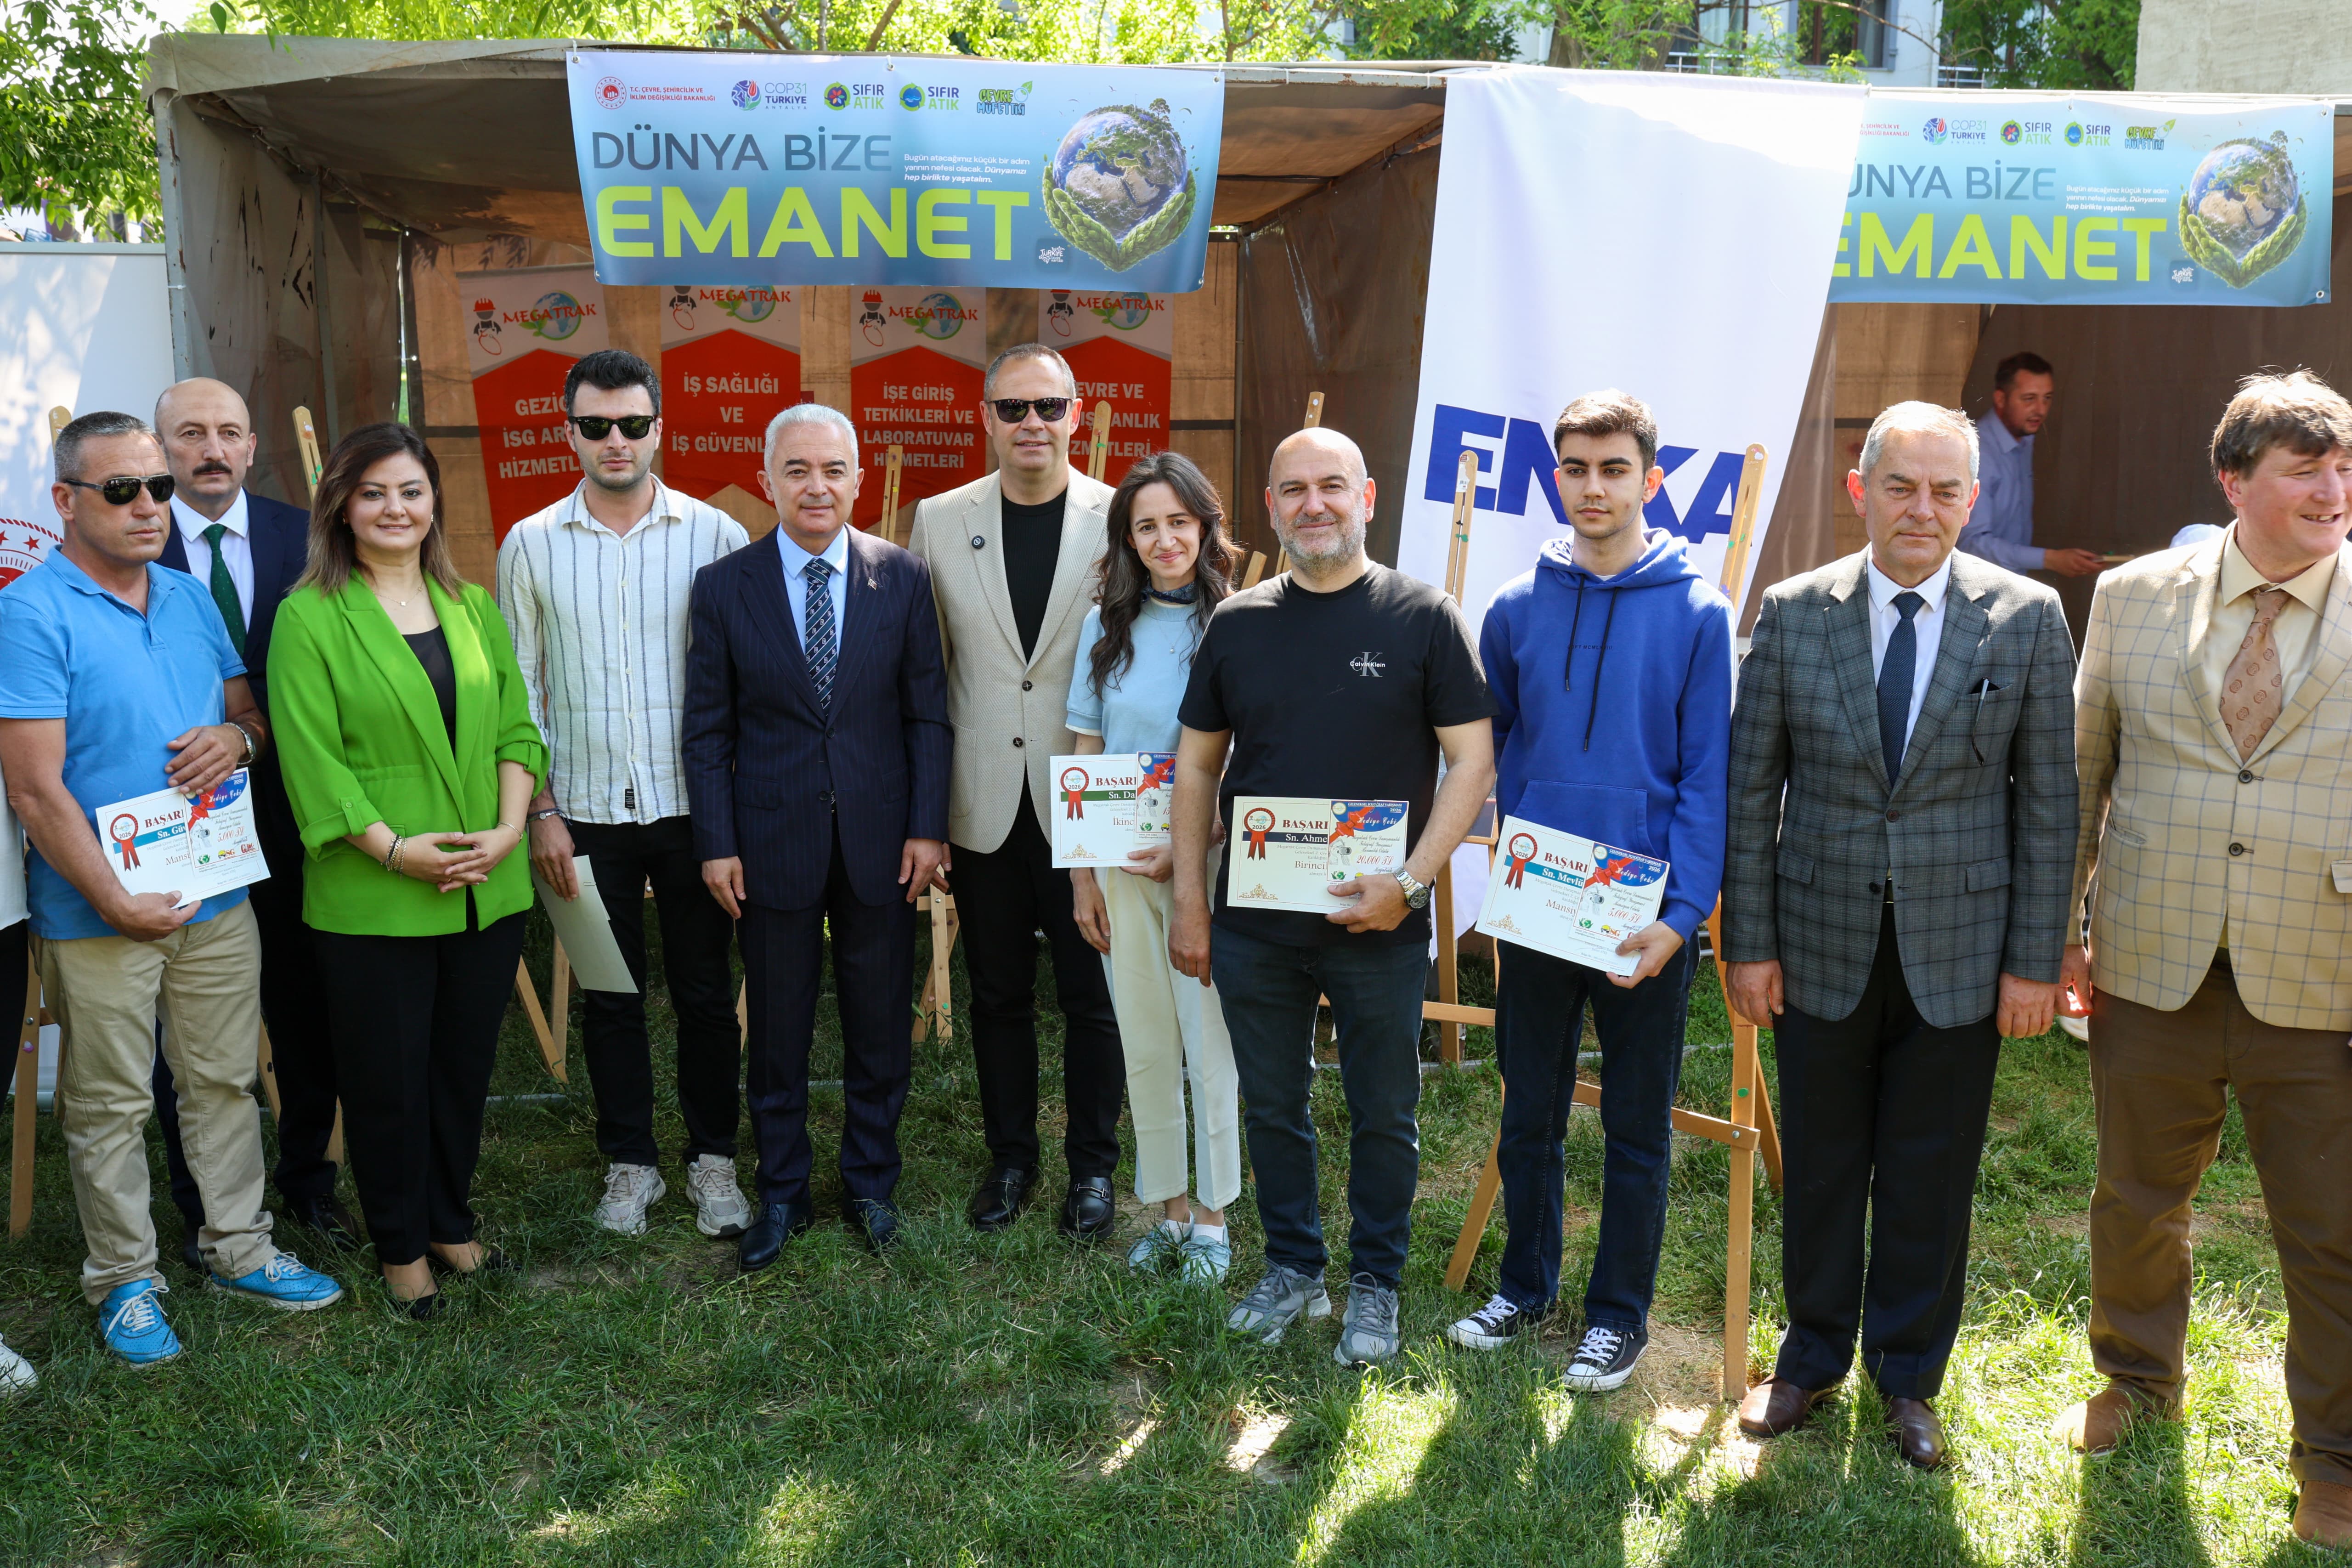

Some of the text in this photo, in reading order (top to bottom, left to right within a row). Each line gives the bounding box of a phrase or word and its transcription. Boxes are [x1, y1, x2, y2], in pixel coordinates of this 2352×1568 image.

[765, 82, 807, 93] COP31
[853, 84, 884, 96] SIFIR
[928, 86, 959, 98] SIFIR
[765, 95, 807, 104] TÜRKİYE
[854, 97, 884, 109] ATIK
[979, 89, 1014, 104] ÇEVRE
[928, 98, 959, 110] ATIK
[1951, 120, 1987, 130] COP31
[2025, 122, 2052, 133] SIFIR
[2086, 125, 2110, 135] SIFIR
[1951, 131, 1986, 140] TÜRKİYE
[2025, 133, 2051, 145] ATIK
[2086, 136, 2110, 146] ATIK
[593, 124, 892, 171] DÜNYA BİZE
[974, 156, 997, 164] küçük
[984, 166, 1026, 175] Dünyamızı
[952, 175, 992, 183] yaşatalım.
[1966, 159, 2057, 201] BİZE
[596, 186, 1029, 260] EMANET
[700, 289, 791, 302] MEGATRAK
[1077, 297, 1165, 311] MEGATRAK
[503, 304, 597, 323] MEGATRAK
[889, 306, 978, 321] MEGATRAK
[684, 371, 779, 397] İŞ SAĞLIĞI
[1076, 382, 1144, 399] EVRE VE
[883, 382, 955, 405] İŞE GİRİŞ
[515, 392, 566, 416] GEZİC
[720, 407, 744, 423] VE
[864, 405, 974, 424] TETKİKLERİ VE
[1080, 411, 1160, 430] IŞANLIK
[503, 426, 567, 448] İSG AR
[672, 431, 765, 456] İŞ GÜVENL
[864, 430, 974, 446] LABORATUVAR
[1070, 438, 1151, 457] ZMTLERİ
[874, 449, 964, 468] HİMETLERİ
[499, 455, 581, 479] HİZMETL
[1113, 816, 1134, 826] İkinc
[1283, 819, 1329, 831] BAŞARI
[158, 825, 186, 839] Sn. Güv
[1301, 834, 1327, 843] Ahme
[166, 851, 191, 866] Mansi
[1295, 860, 1327, 870] Birinci
[1357, 855, 1380, 864] 20.000
[1544, 852, 1588, 873] BAŞARI
[1542, 868, 1583, 887] Sn. Mevlü
[1546, 899, 1577, 917] Mansiy
[1608, 908, 1628, 919] 5.000
